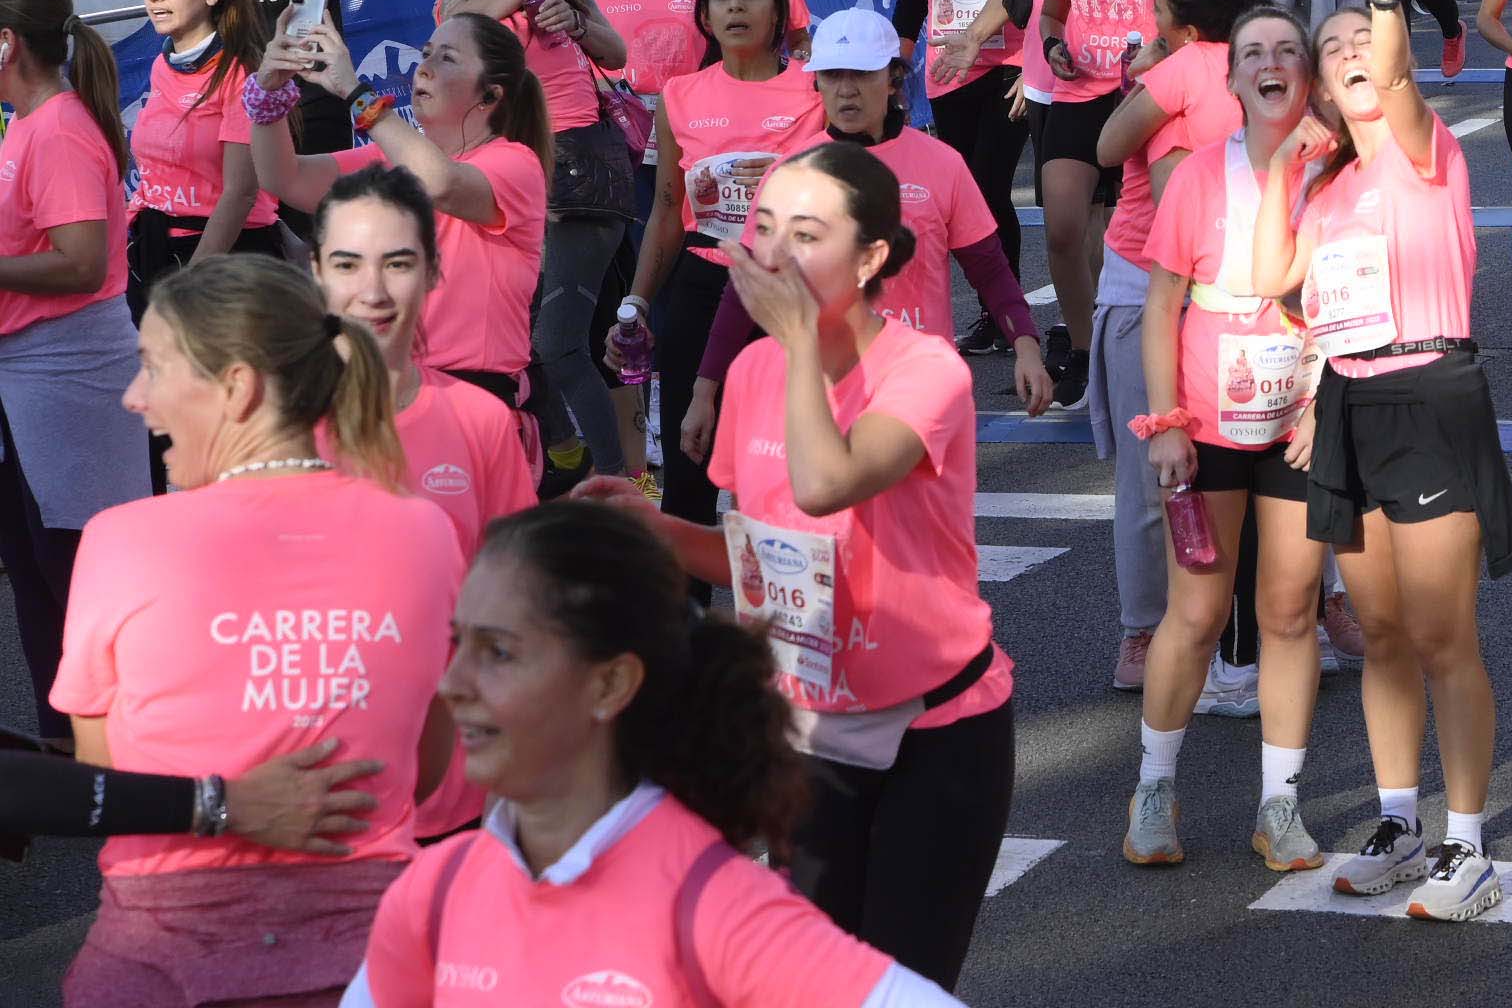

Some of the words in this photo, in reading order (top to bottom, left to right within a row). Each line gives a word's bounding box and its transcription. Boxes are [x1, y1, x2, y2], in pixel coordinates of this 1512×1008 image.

[606, 2, 642, 15] OYSHO
[956, 9, 980, 19] 016
[688, 116, 730, 129] OYSHO
[721, 185, 754, 201] 016
[1321, 285, 1350, 305] 016
[1259, 375, 1295, 395] 016
[1266, 395, 1289, 408] 8476
[1232, 410, 1266, 420] CARRERA
[1229, 426, 1268, 438] OYSHO
[767, 581, 806, 609] 016
[210, 608, 403, 645] CARRERA
[250, 643, 302, 677] DE
[319, 642, 367, 676] LA
[241, 677, 371, 713] MUJER
